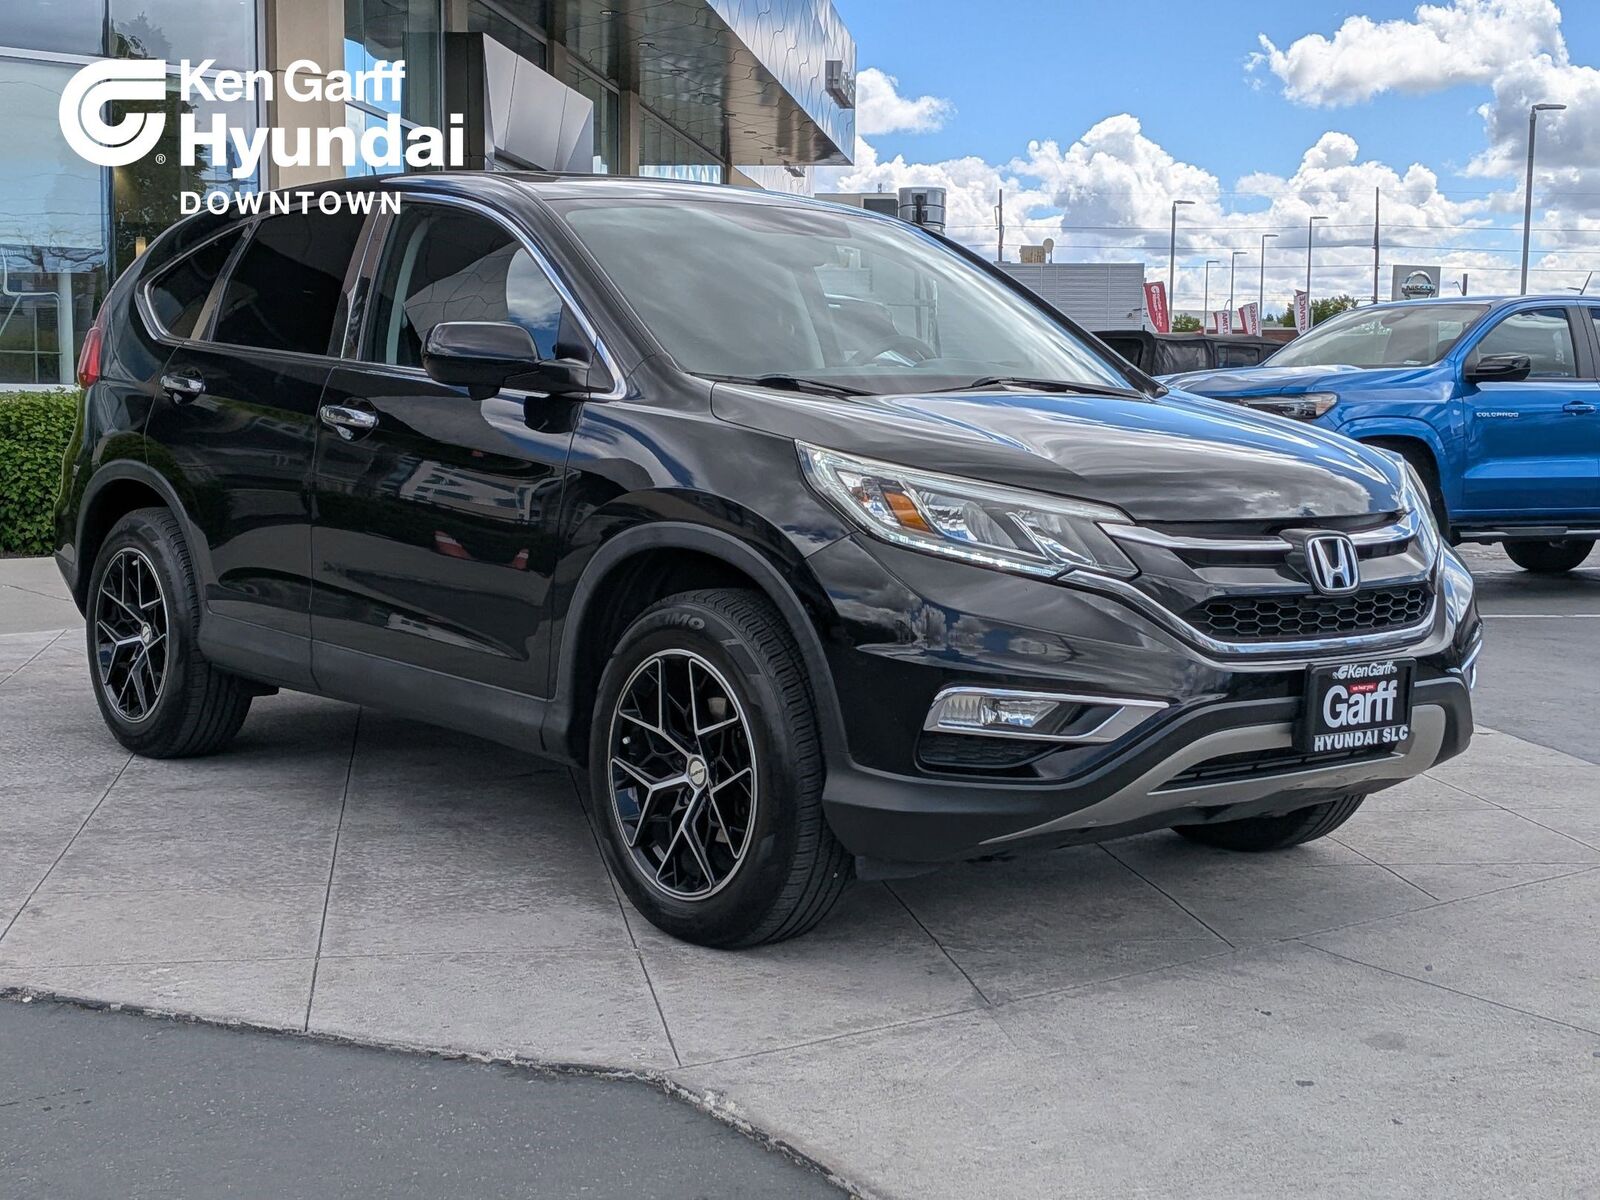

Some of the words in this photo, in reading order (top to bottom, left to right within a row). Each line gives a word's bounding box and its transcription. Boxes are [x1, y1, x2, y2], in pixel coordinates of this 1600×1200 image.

[1347, 663, 1368, 679] Ken
[1368, 660, 1394, 677] Garff
[1322, 680, 1398, 728] Garff
[1314, 730, 1379, 752] HYUNDAI
[1382, 725, 1409, 743] SLC
